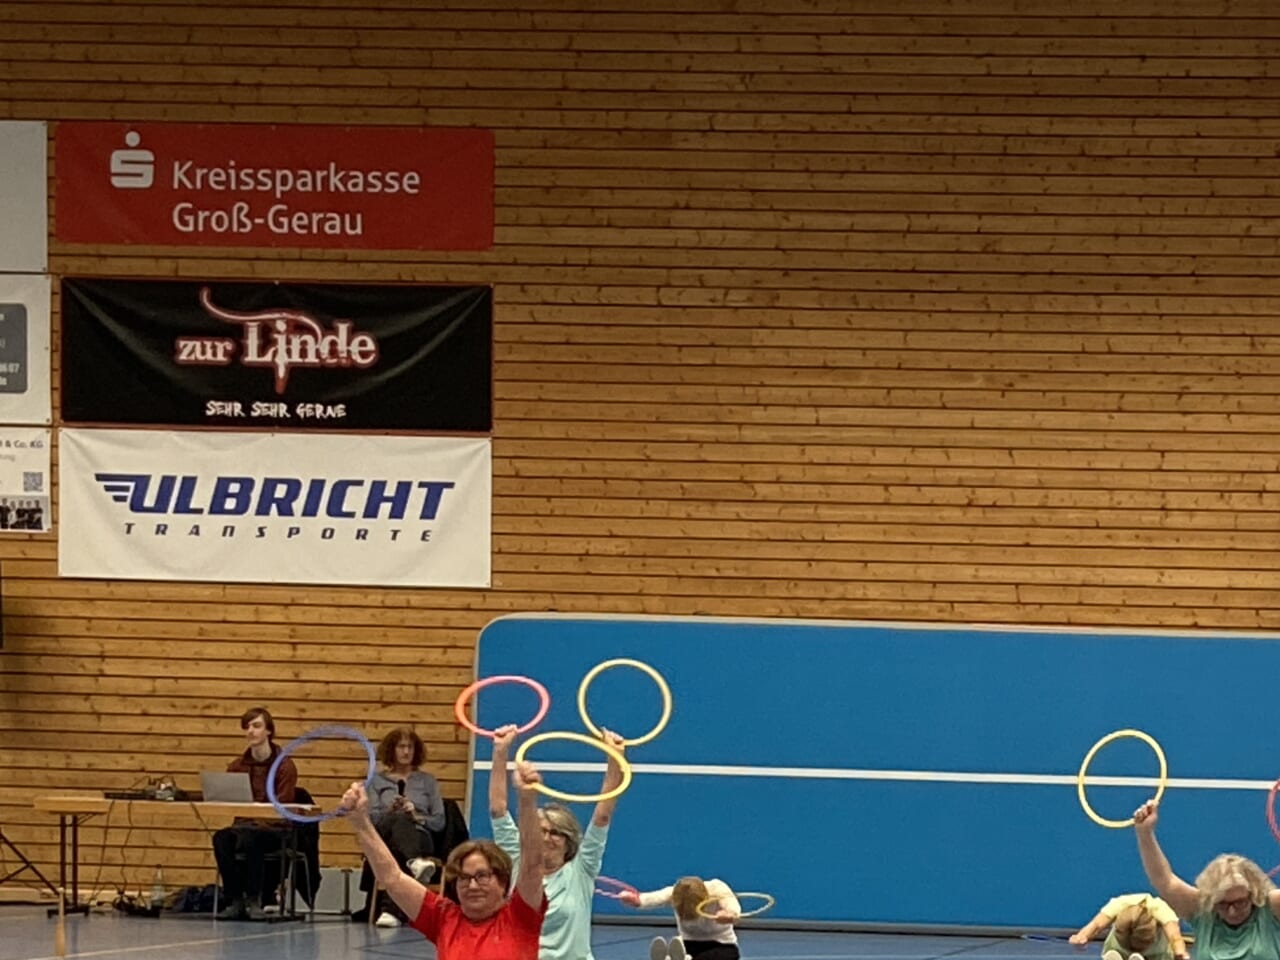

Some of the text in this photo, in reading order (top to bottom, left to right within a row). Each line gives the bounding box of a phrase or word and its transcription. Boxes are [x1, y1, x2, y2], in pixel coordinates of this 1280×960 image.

[172, 160, 421, 199] Kreissparkasse
[172, 202, 364, 236] Groß-Gerau
[178, 338, 233, 362] zur
[243, 319, 377, 366] Linde
[205, 400, 347, 418] SEHR SEHR GERNE
[95, 473, 456, 520] ULBRICHT
[124, 522, 433, 542] TRANSPORTE
